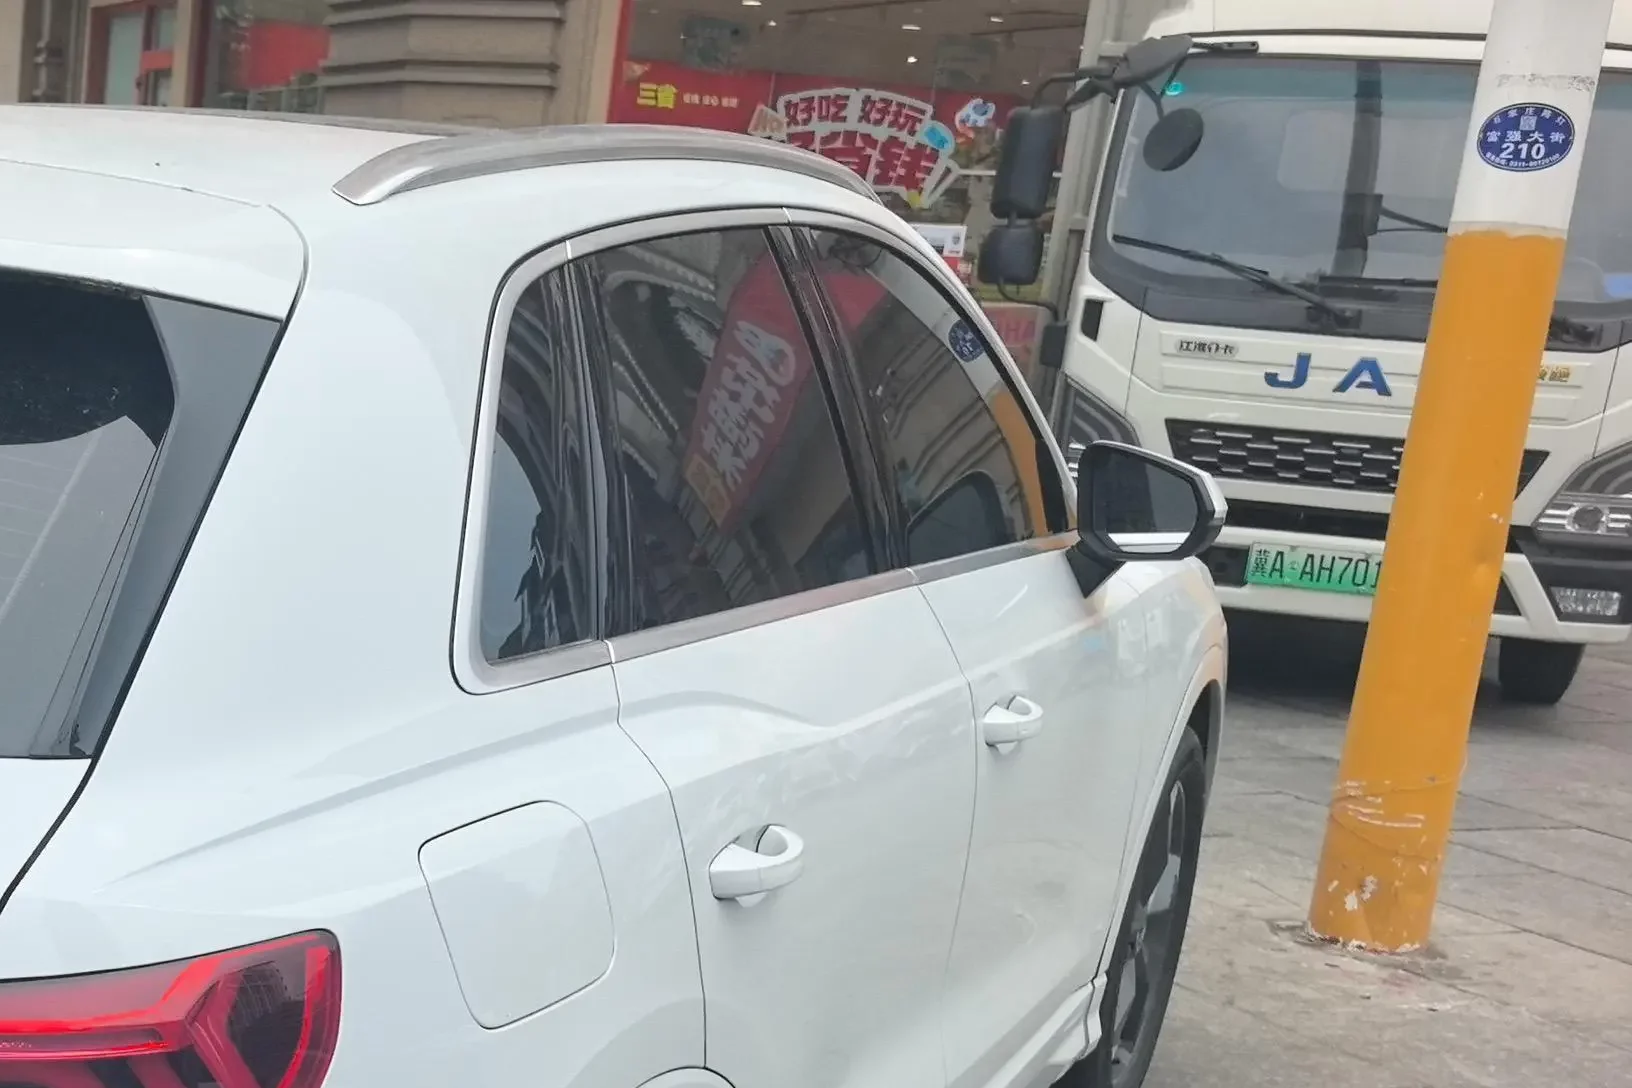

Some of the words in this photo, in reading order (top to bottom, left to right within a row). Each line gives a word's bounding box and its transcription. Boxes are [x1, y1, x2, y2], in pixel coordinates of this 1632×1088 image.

[784, 94, 849, 127] 好吃
[858, 94, 924, 137] 好玩
[1485, 130, 1566, 144] 富强大街
[1498, 142, 1546, 160] 210
[1252, 548, 1285, 579] 冀A
